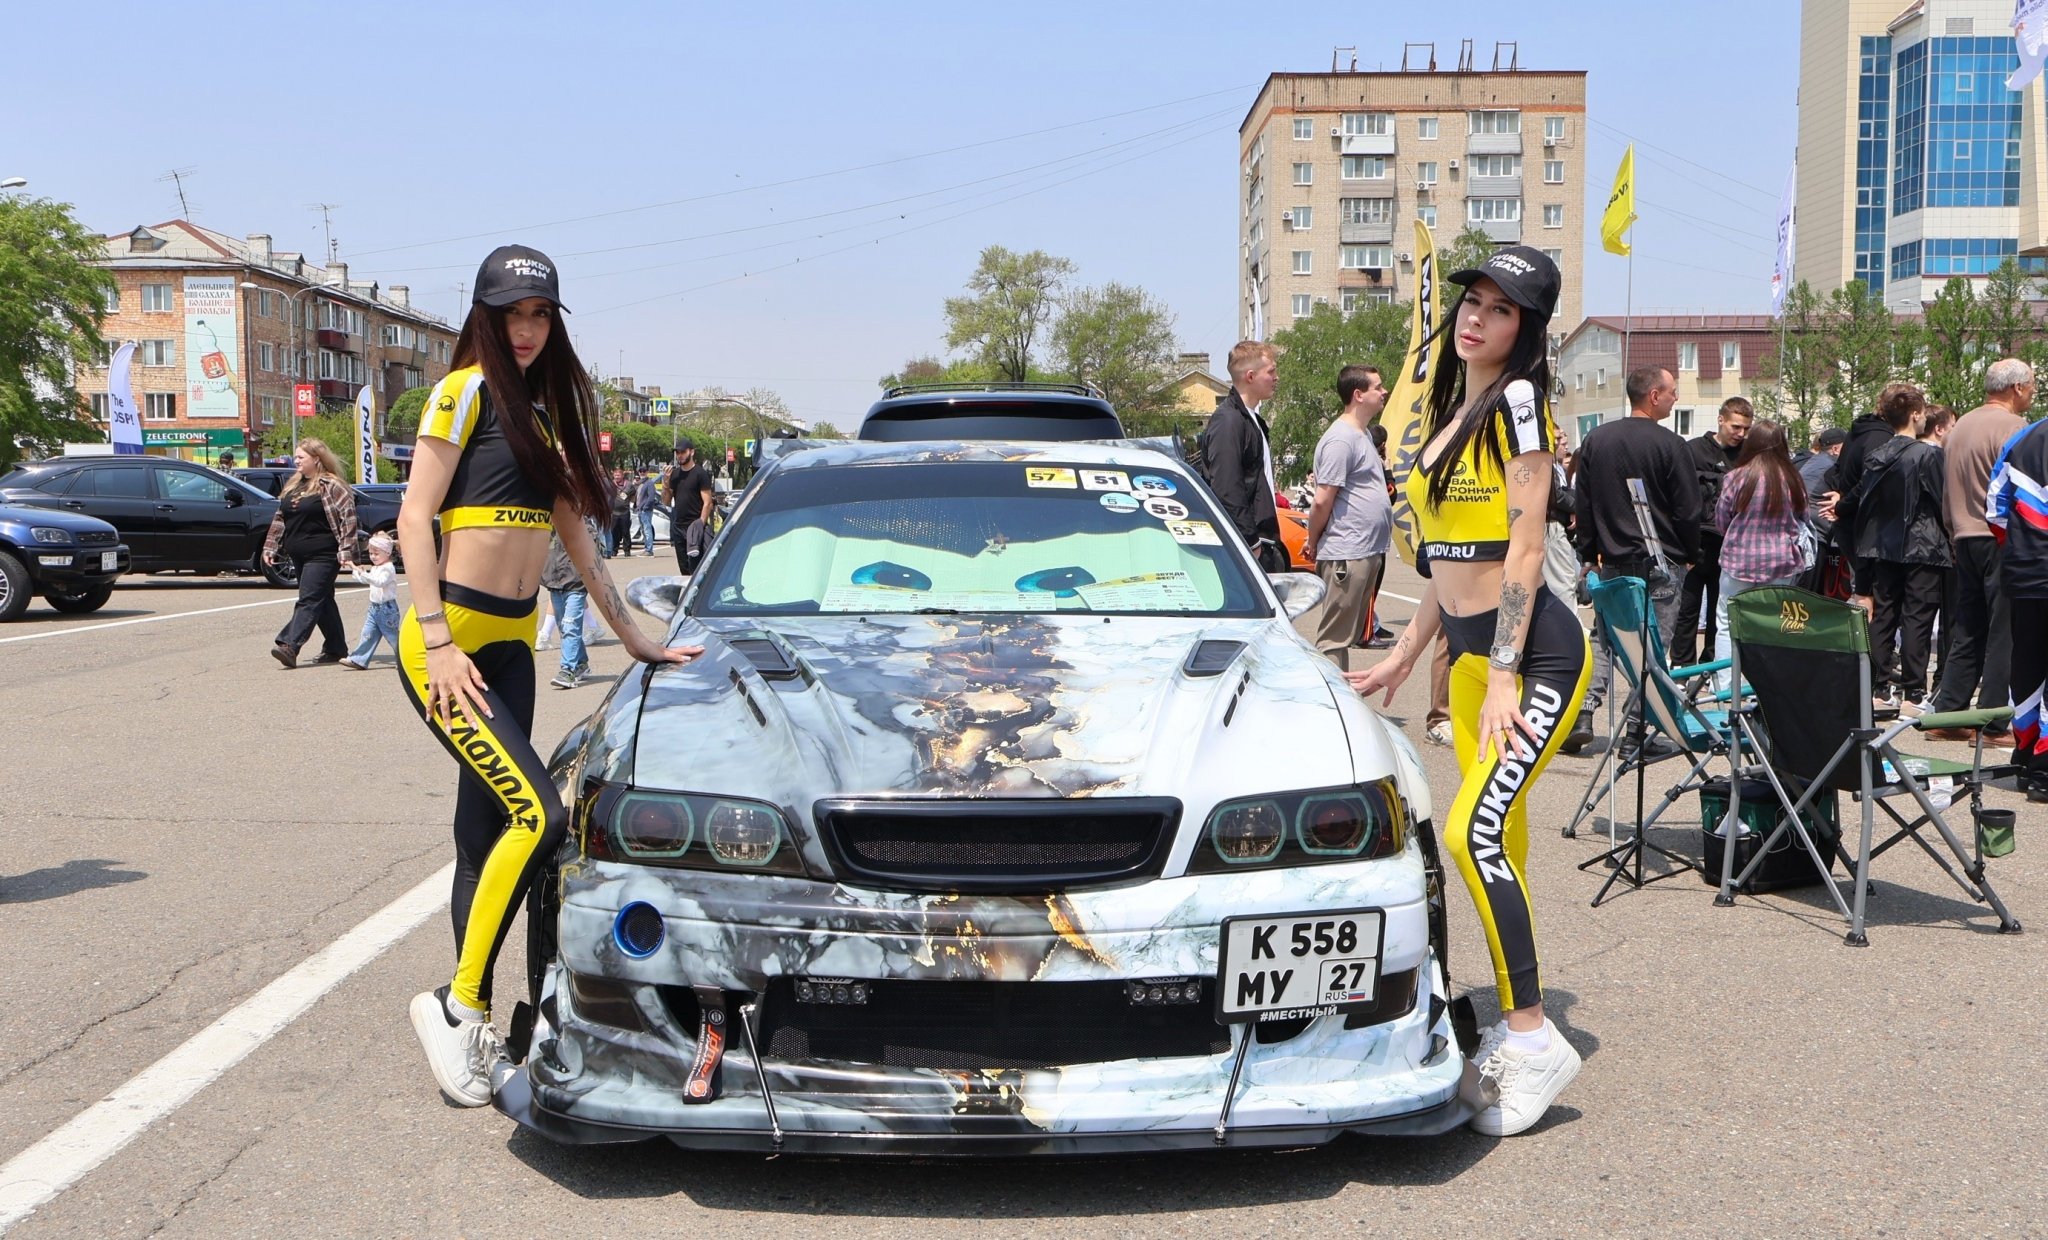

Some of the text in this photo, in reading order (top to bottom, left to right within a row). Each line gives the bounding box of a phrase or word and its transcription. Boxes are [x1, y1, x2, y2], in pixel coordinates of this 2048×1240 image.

[505, 258, 551, 274] ZVUKDV
[1490, 260, 1524, 276] TEAM
[514, 267, 547, 280] TEAM
[198, 291, 231, 299] САХАРА
[188, 299, 223, 307] БОЛЬШЕ
[196, 307, 231, 315] ПОЛЬЗЫ
[146, 432, 207, 440] ZELECTRONIC
[1030, 473, 1056, 482] 57
[1093, 475, 1120, 485] 51
[1142, 480, 1170, 491] 53
[1150, 503, 1185, 517] 55
[1173, 526, 1196, 536] 53
[1472, 683, 1562, 884] ZVUKDV.RU
[1290, 920, 1358, 957] 558
[1237, 963, 1366, 1006] МУ 27
[1325, 991, 1348, 1001] RUS
[1260, 1004, 1338, 1022] #МЕСТНЫЙ
